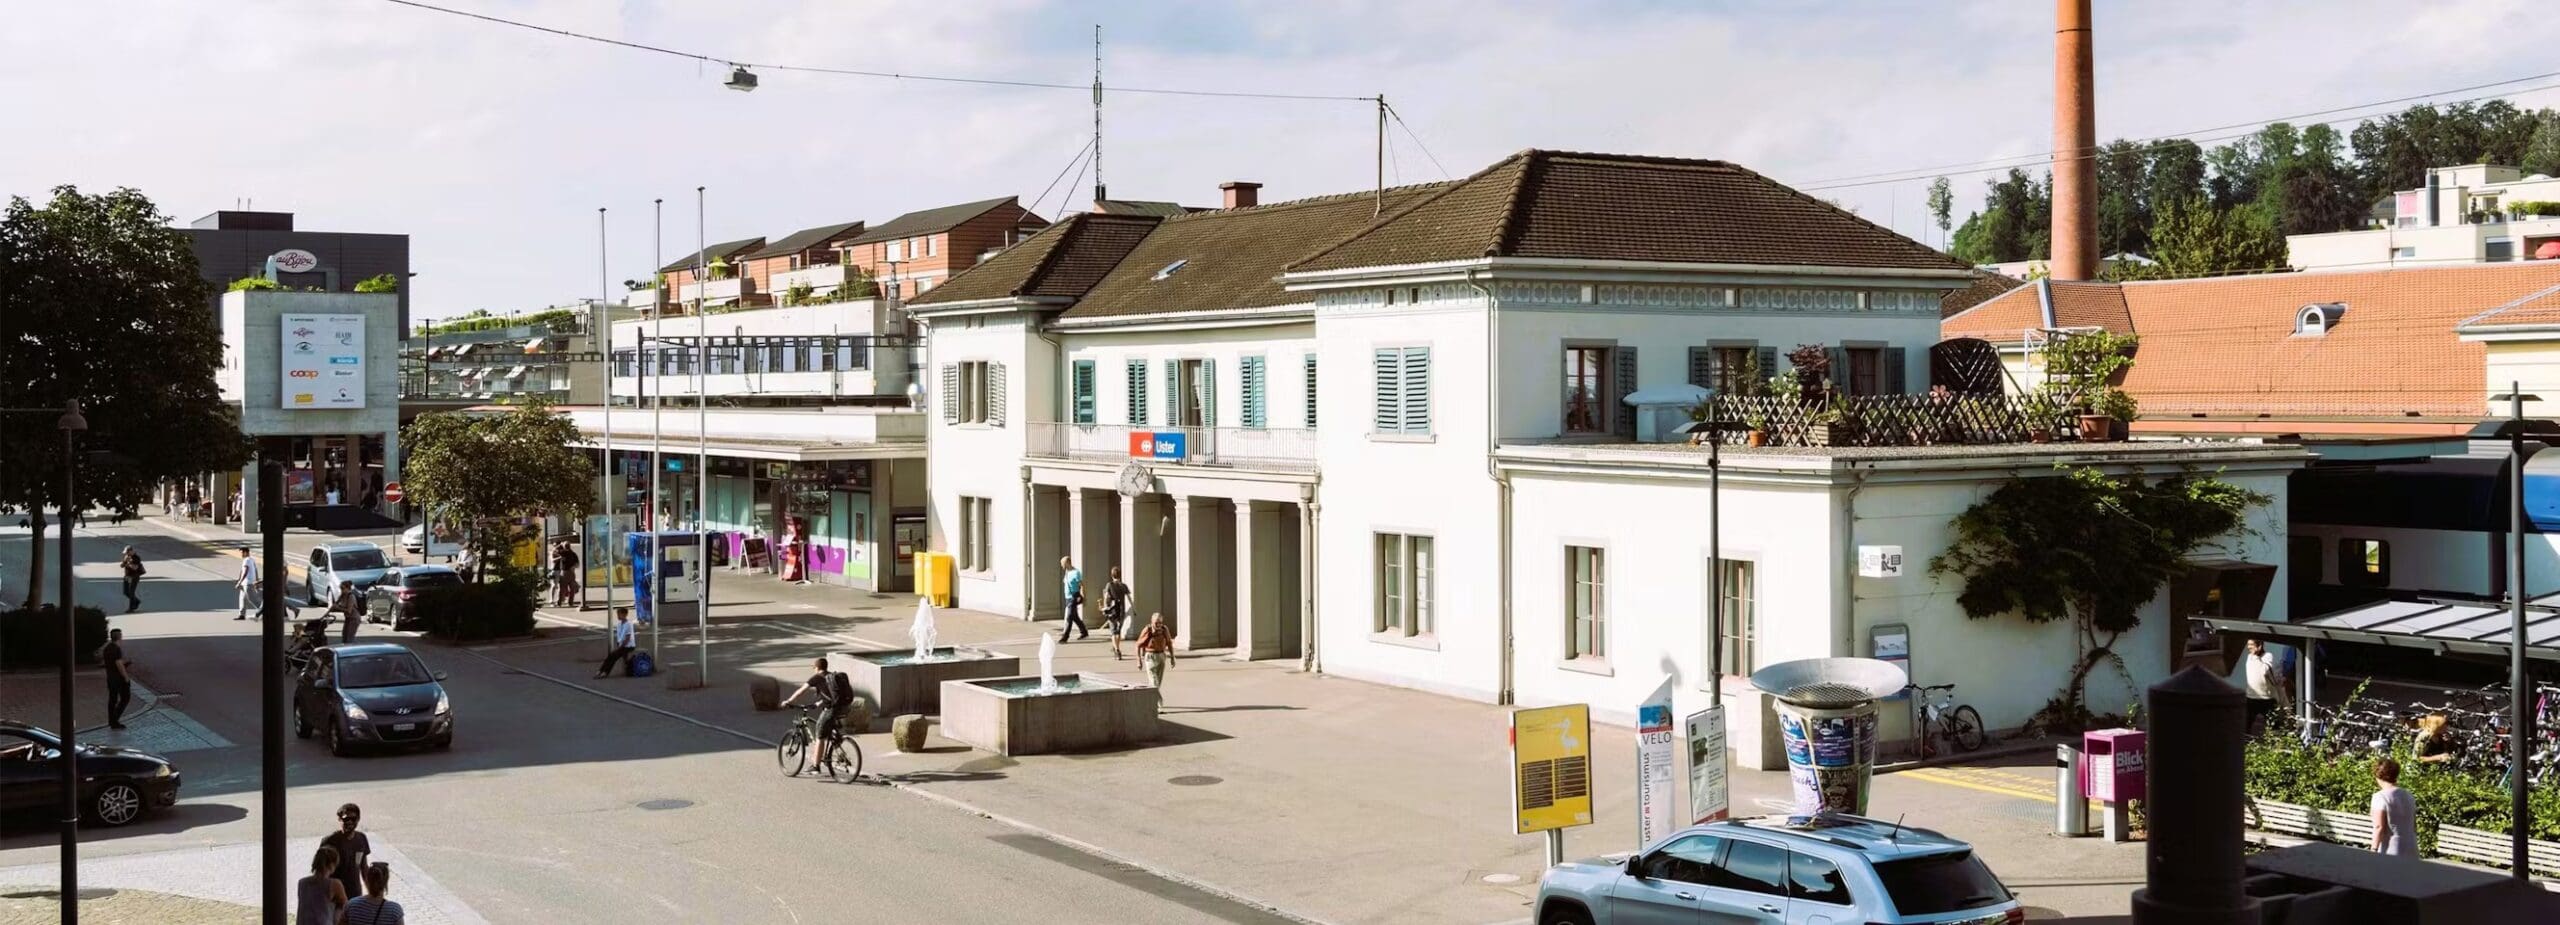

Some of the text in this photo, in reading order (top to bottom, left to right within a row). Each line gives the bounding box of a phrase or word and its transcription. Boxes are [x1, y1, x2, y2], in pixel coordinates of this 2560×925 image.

[290, 370, 319, 379] coop
[1156, 440, 1176, 453] Uster
[1642, 732, 1672, 745] VELO
[2116, 749, 2144, 767] Blick
[1643, 752, 1651, 806] tourismus
